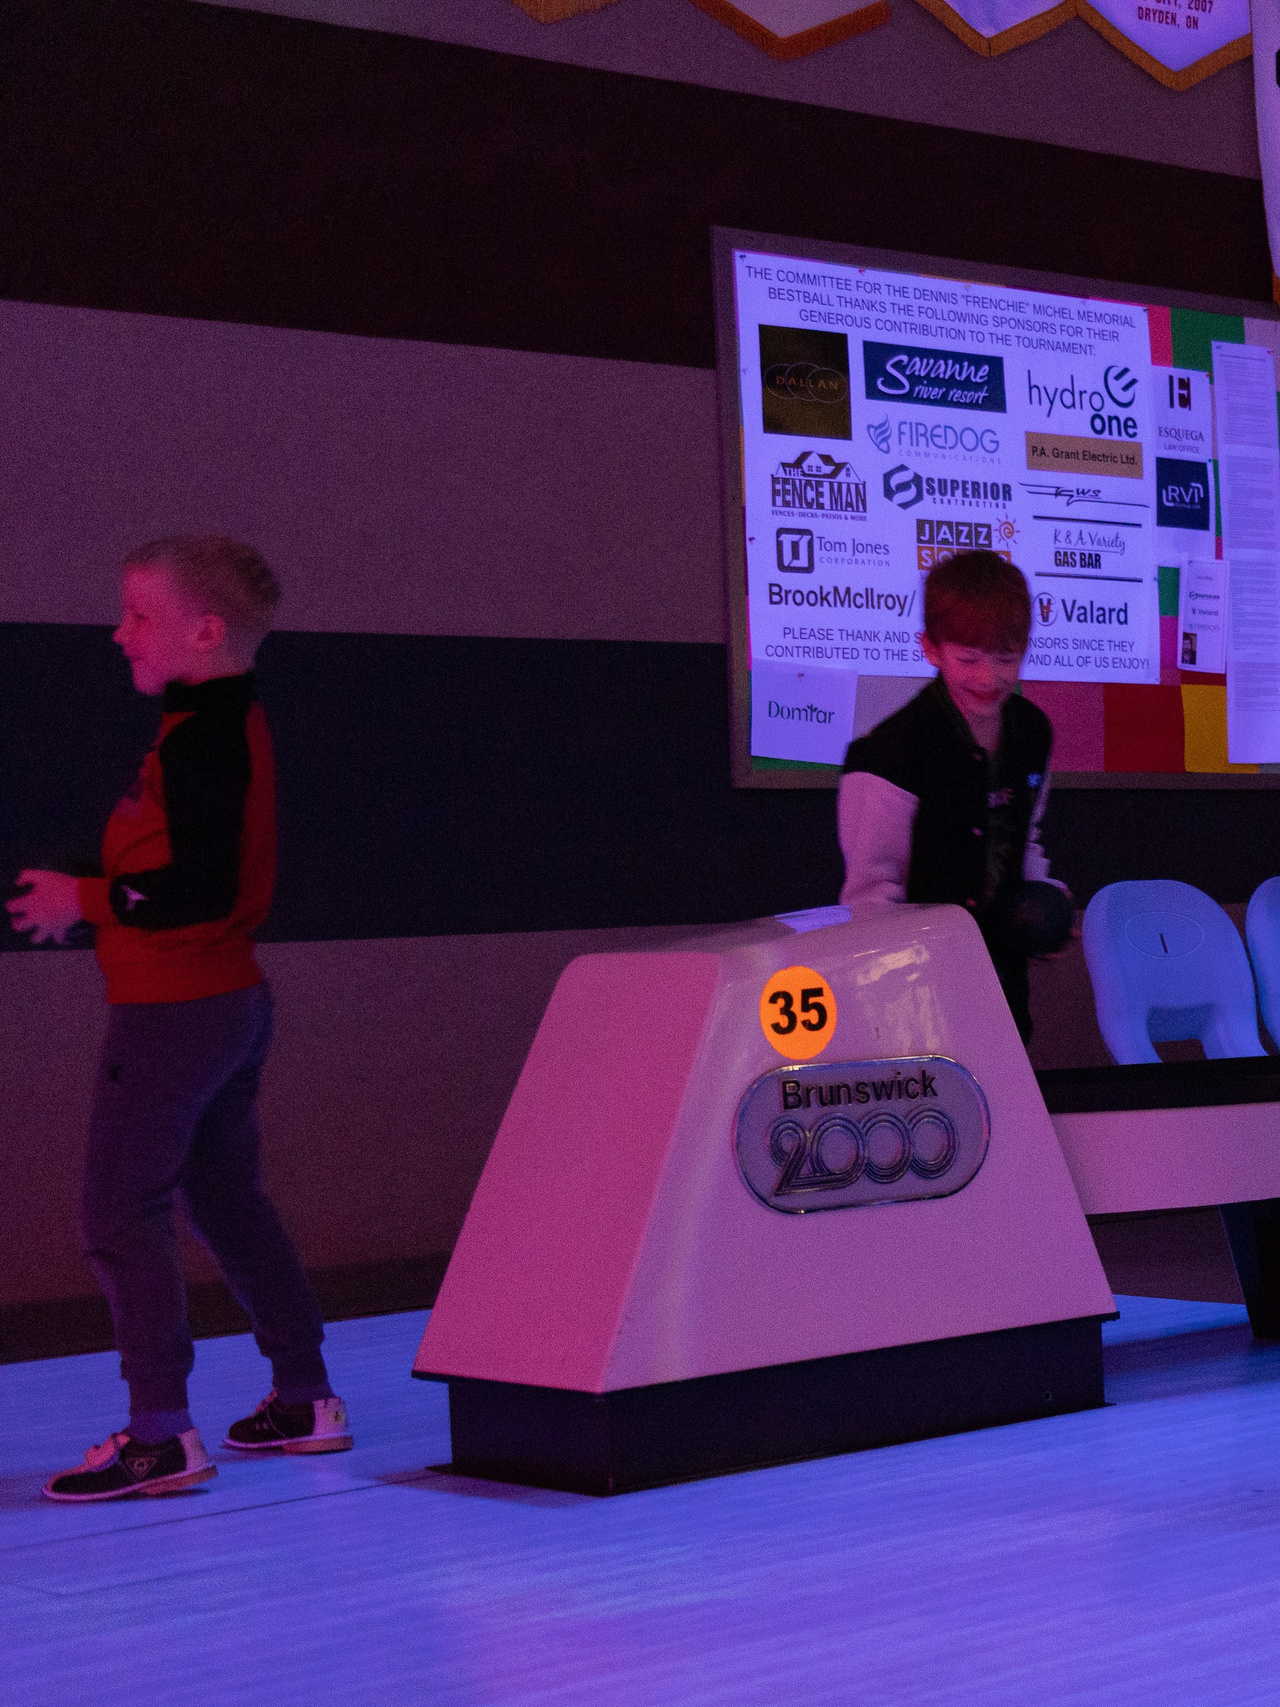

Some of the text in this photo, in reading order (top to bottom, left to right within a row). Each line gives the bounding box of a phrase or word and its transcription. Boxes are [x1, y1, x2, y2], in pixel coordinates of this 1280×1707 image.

[1137, 6, 1199, 30] DRYDEN, ON
[1187, 0, 1214, 13] 2007
[745, 265, 1137, 328] THE COMMITTEE FOR THE DENNIS "FRENCHIE" MICHEL MEMORIAL
[768, 287, 1120, 343] BESTBALL THANKS THE FOLLOWING SPONSORS FOR THEIR
[799, 308, 1097, 357] GENEROUS CONTRIBUTION TO THE TOURNAMENT:
[775, 374, 839, 391] DALLAN
[876, 354, 990, 395] Savanne
[912, 380, 989, 404] river resort
[1027, 369, 1105, 418] hydro
[897, 421, 1000, 454] FIREDOG
[1090, 413, 1138, 438] one
[1158, 426, 1204, 442] ESQUEGA
[1031, 445, 1139, 465] P.A. Grant Electric Ltd.
[1163, 443, 1200, 454] LAW OFFICE
[771, 476, 867, 513] FENCE MAN
[925, 476, 1013, 502] SUPERIOR
[919, 523, 990, 545] JAZZ
[1054, 528, 1062, 545] K
[1064, 530, 1072, 545] &
[1088, 532, 1126, 556] Variety
[816, 536, 890, 557] Tom Jones
[819, 557, 890, 568] CORPORATION
[1054, 550, 1102, 569] GAS BAR
[1061, 598, 1129, 626] Valard
[783, 626, 834, 641] PLEASE
[838, 628, 882, 643] THANK
[883, 631, 911, 643] AND
[1028, 636, 1135, 653] NSORS SINCE THEY
[765, 644, 860, 660] CONTRIBUTED
[864, 648, 881, 661] TO
[883, 649, 909, 662] THE
[1027, 653, 1150, 670] AND ALL OF US ENJOY!
[768, 700, 835, 724] Domtar
[768, 987, 828, 1036] 35
[781, 1069, 939, 1110] Brunswick
[769, 1104, 959, 1197] 2000
